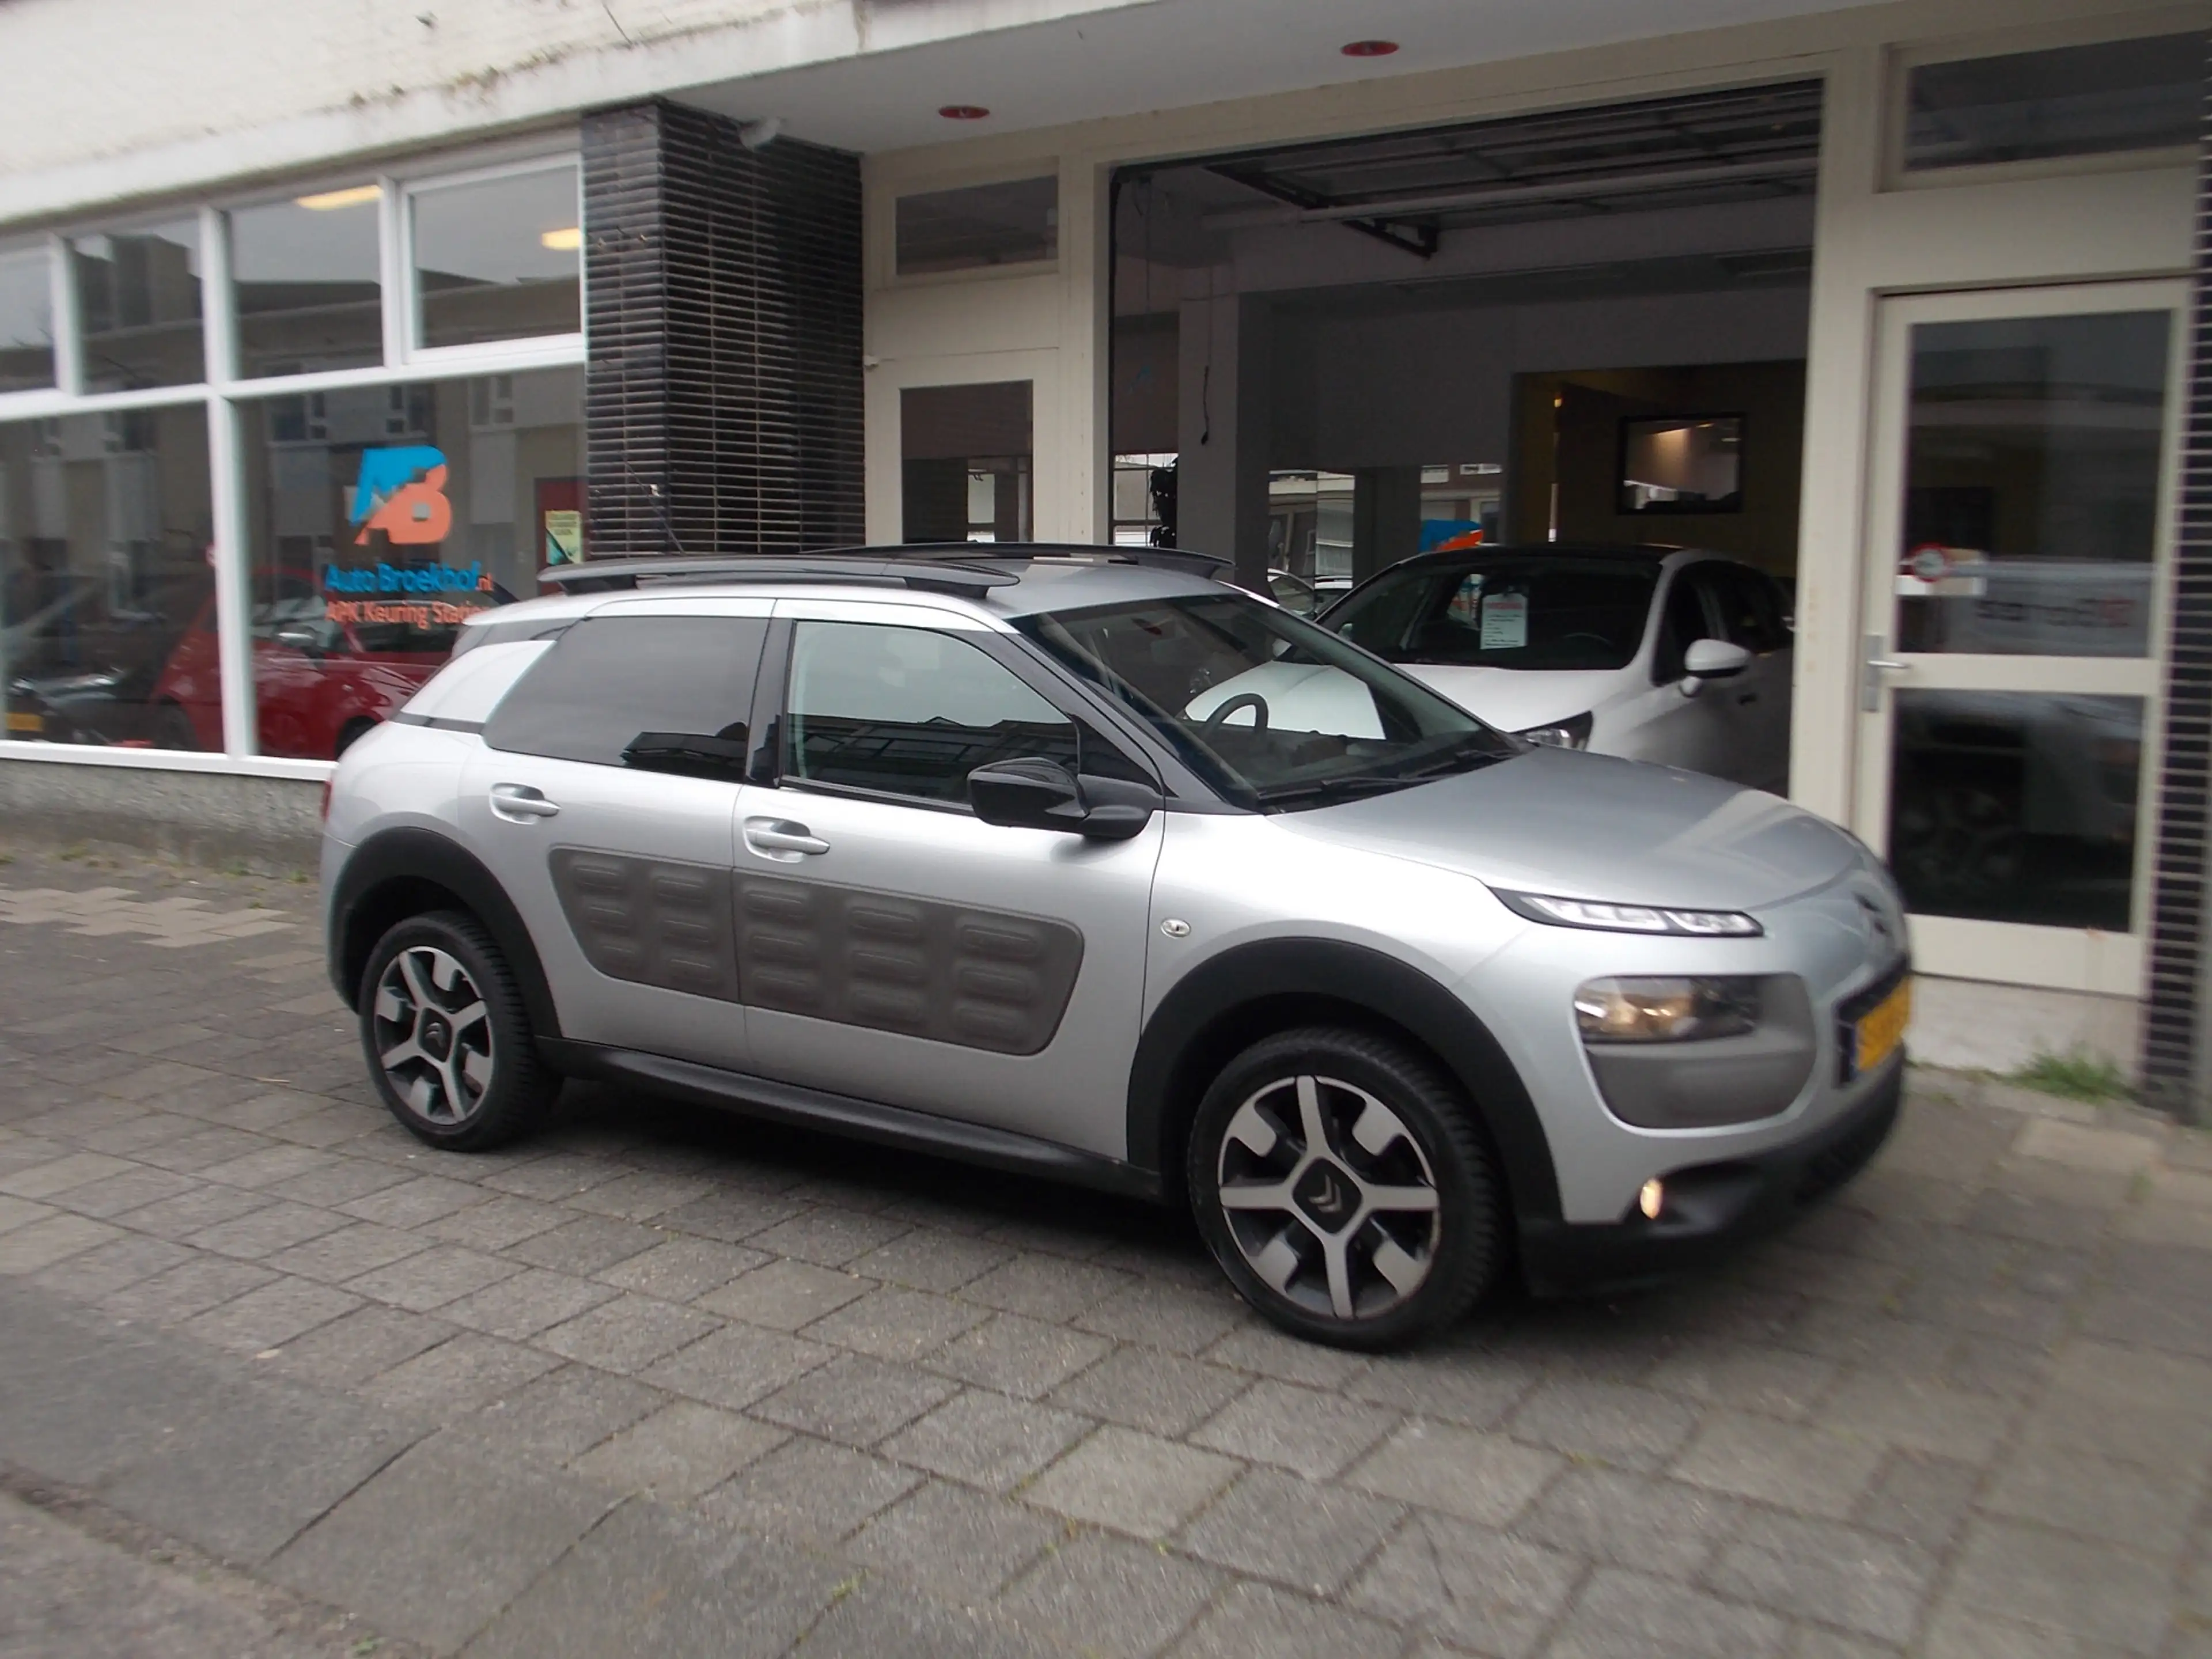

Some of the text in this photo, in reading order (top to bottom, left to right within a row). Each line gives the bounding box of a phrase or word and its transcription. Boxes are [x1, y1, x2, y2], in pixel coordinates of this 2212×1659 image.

[325, 563, 376, 592] Auto
[325, 601, 361, 623] APK
[364, 600, 430, 630] Keuring
